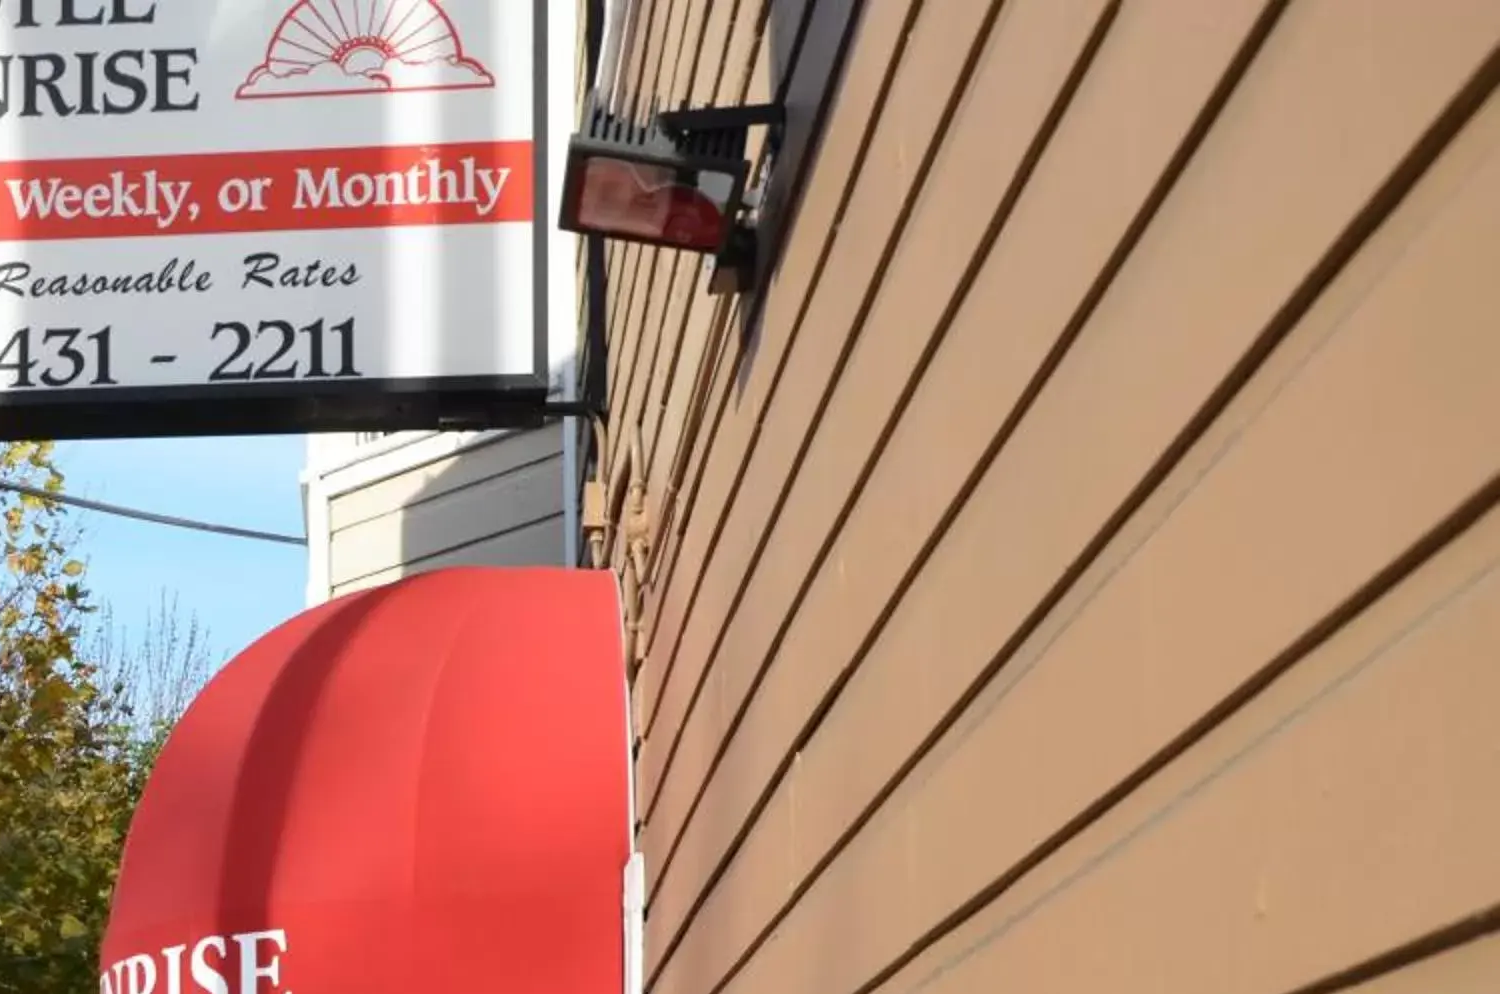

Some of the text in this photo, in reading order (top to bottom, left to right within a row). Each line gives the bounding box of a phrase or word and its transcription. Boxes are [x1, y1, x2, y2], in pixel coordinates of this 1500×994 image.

[5, 169, 200, 229] Weekly,
[218, 177, 272, 212] or
[293, 158, 511, 210] Monthly
[242, 252, 361, 290] Rates
[209, 317, 362, 382] 2211
